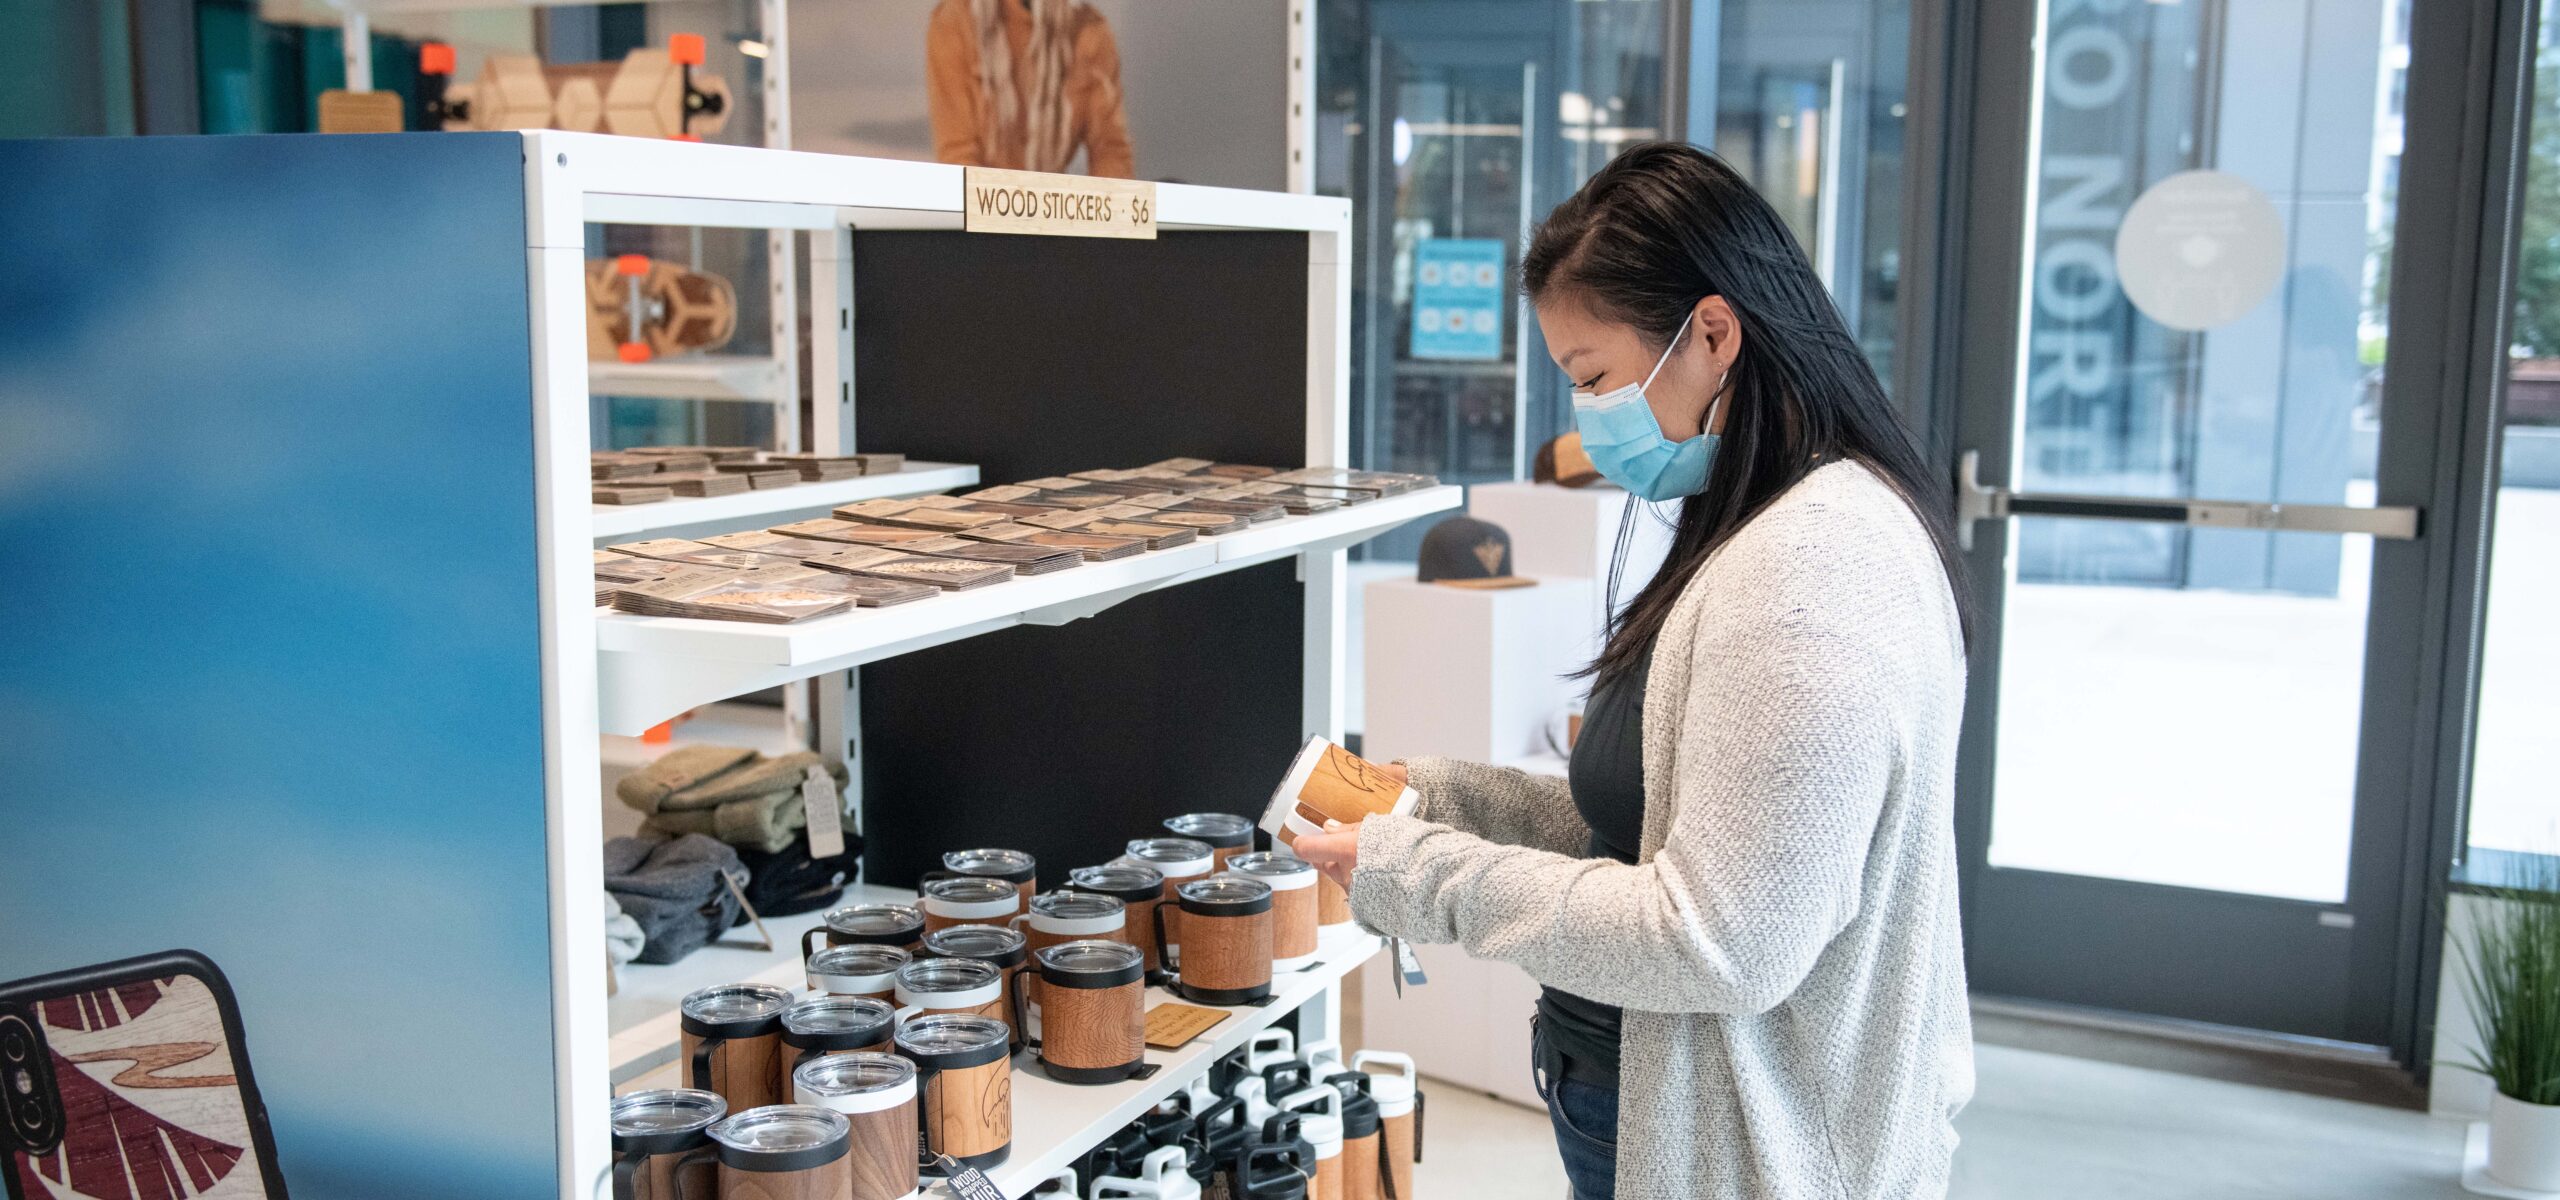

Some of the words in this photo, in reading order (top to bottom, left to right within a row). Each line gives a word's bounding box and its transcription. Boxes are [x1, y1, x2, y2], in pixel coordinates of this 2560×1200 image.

[976, 187, 1038, 218] WOOD
[1043, 191, 1112, 222] STICKERS
[1131, 195, 1149, 227] $6
[950, 1167, 981, 1190] WOOD
[959, 1177, 988, 1198] WRAPPED
